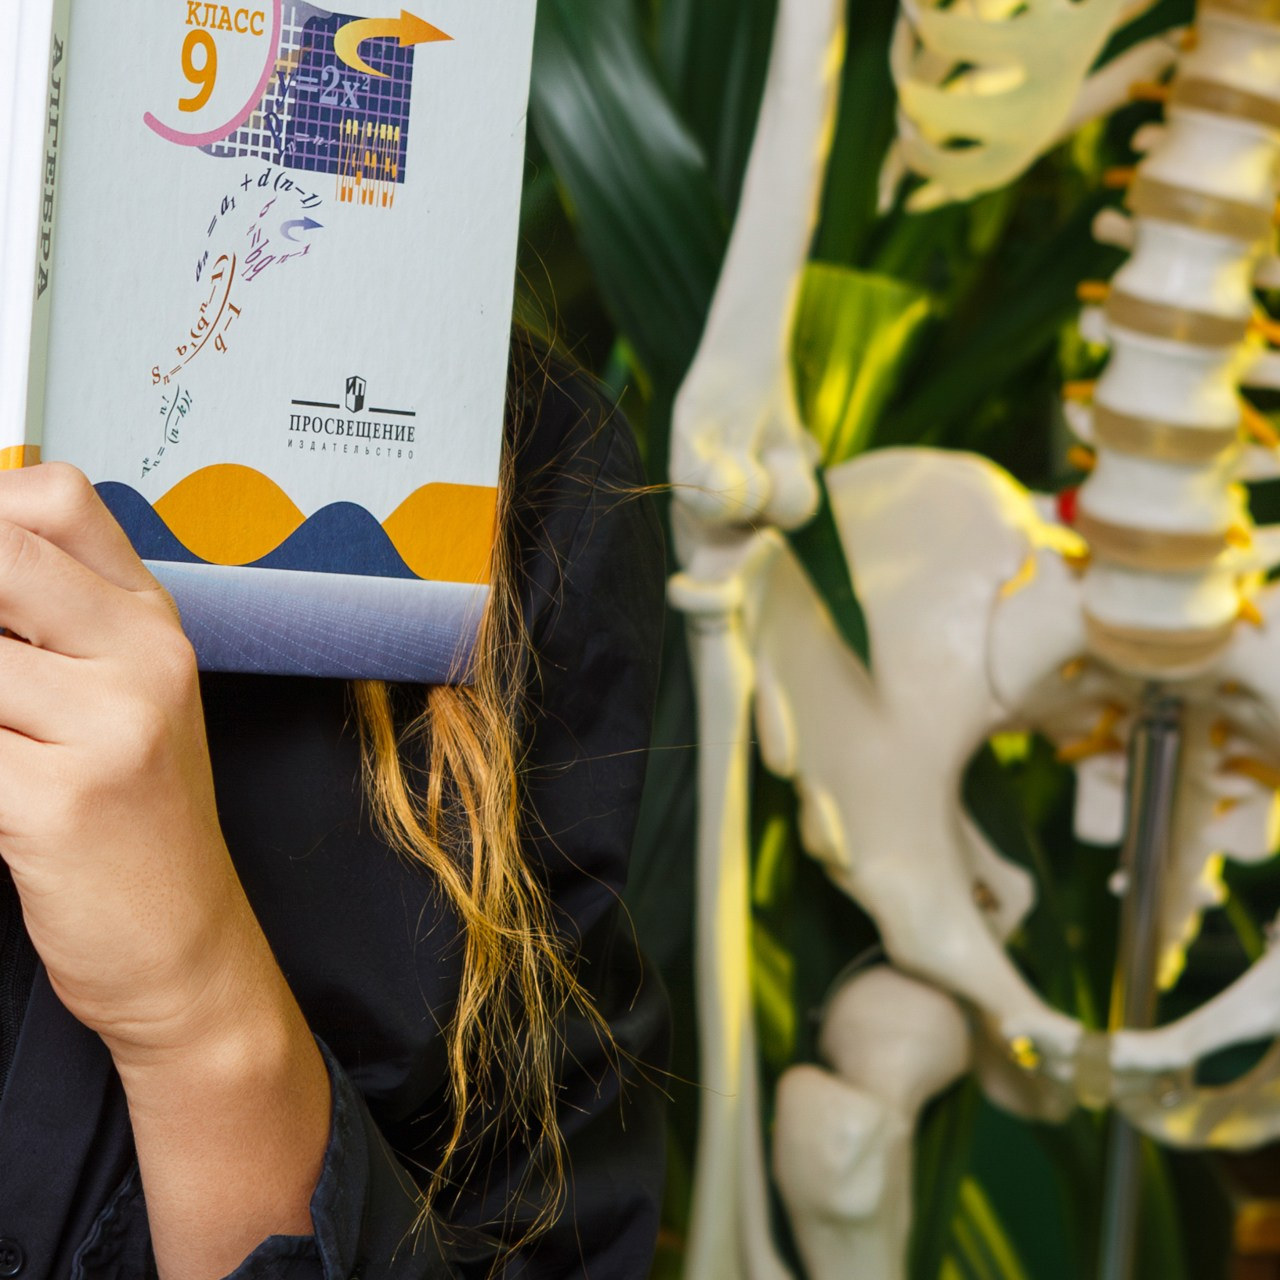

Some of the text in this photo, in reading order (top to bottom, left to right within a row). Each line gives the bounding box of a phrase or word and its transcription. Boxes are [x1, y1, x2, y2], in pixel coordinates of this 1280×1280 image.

[186, 0, 265, 37] КЛАСС
[178, 30, 218, 112] 9
[37, 34, 64, 301] АЛГЕБРА
[289, 414, 416, 442] ПРОСВЕЩЕНИЕ
[287, 438, 414, 460] ИЗДАТЕЛЬСТВО
